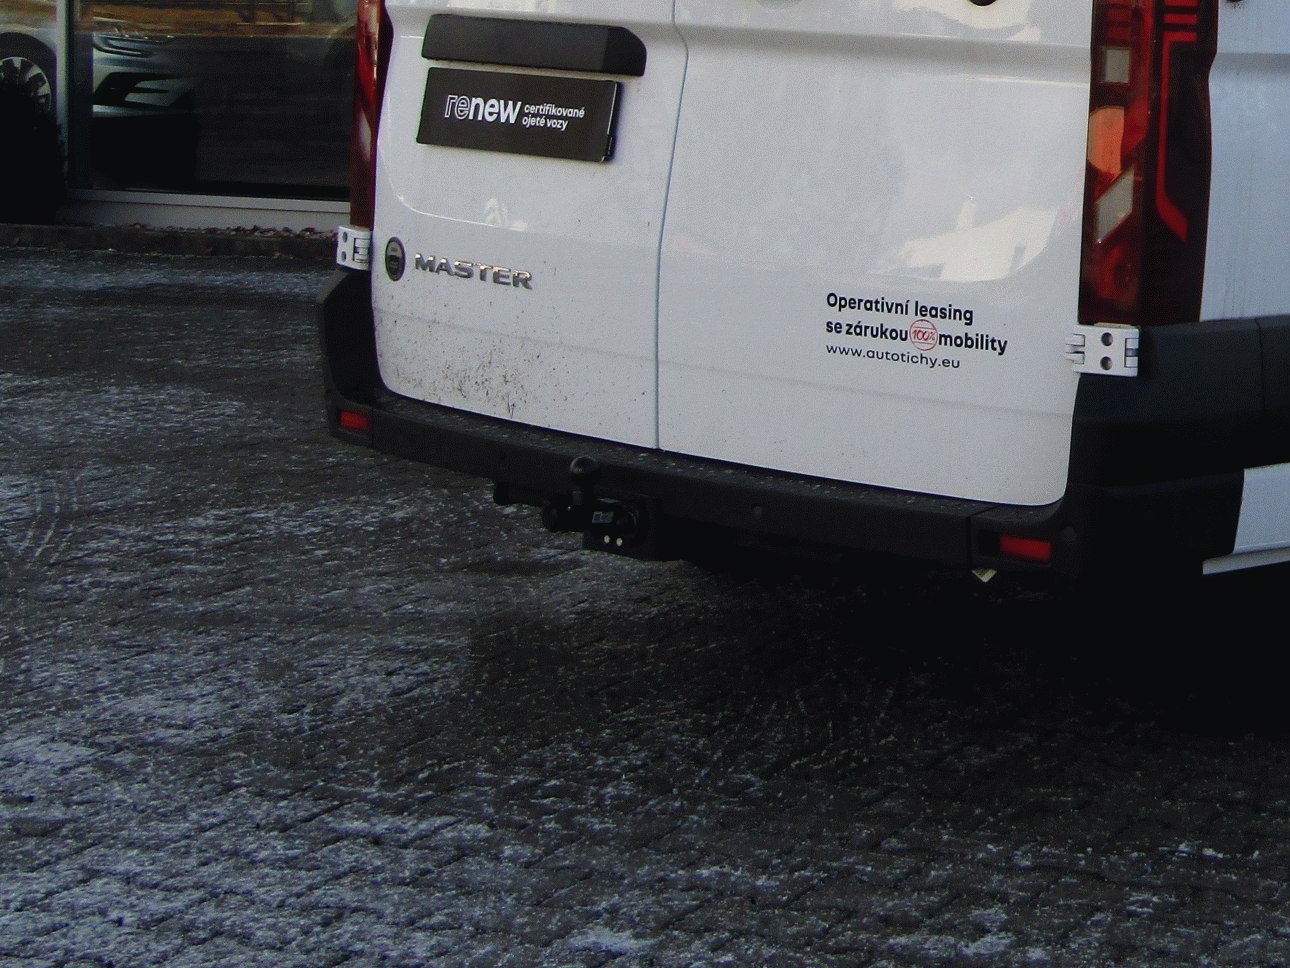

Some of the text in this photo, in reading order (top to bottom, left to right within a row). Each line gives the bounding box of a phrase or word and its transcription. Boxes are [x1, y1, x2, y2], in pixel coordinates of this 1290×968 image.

[444, 94, 522, 124] renew
[521, 114, 569, 132] ojeté vozy
[523, 103, 586, 119] certifikované
[414, 251, 534, 290] MASTER
[826, 292, 974, 326] Operativní leasing
[825, 320, 843, 334] se
[845, 320, 909, 342] zárukou
[938, 332, 1008, 356] mobility
[825, 343, 961, 369] www.autotichy.eu
